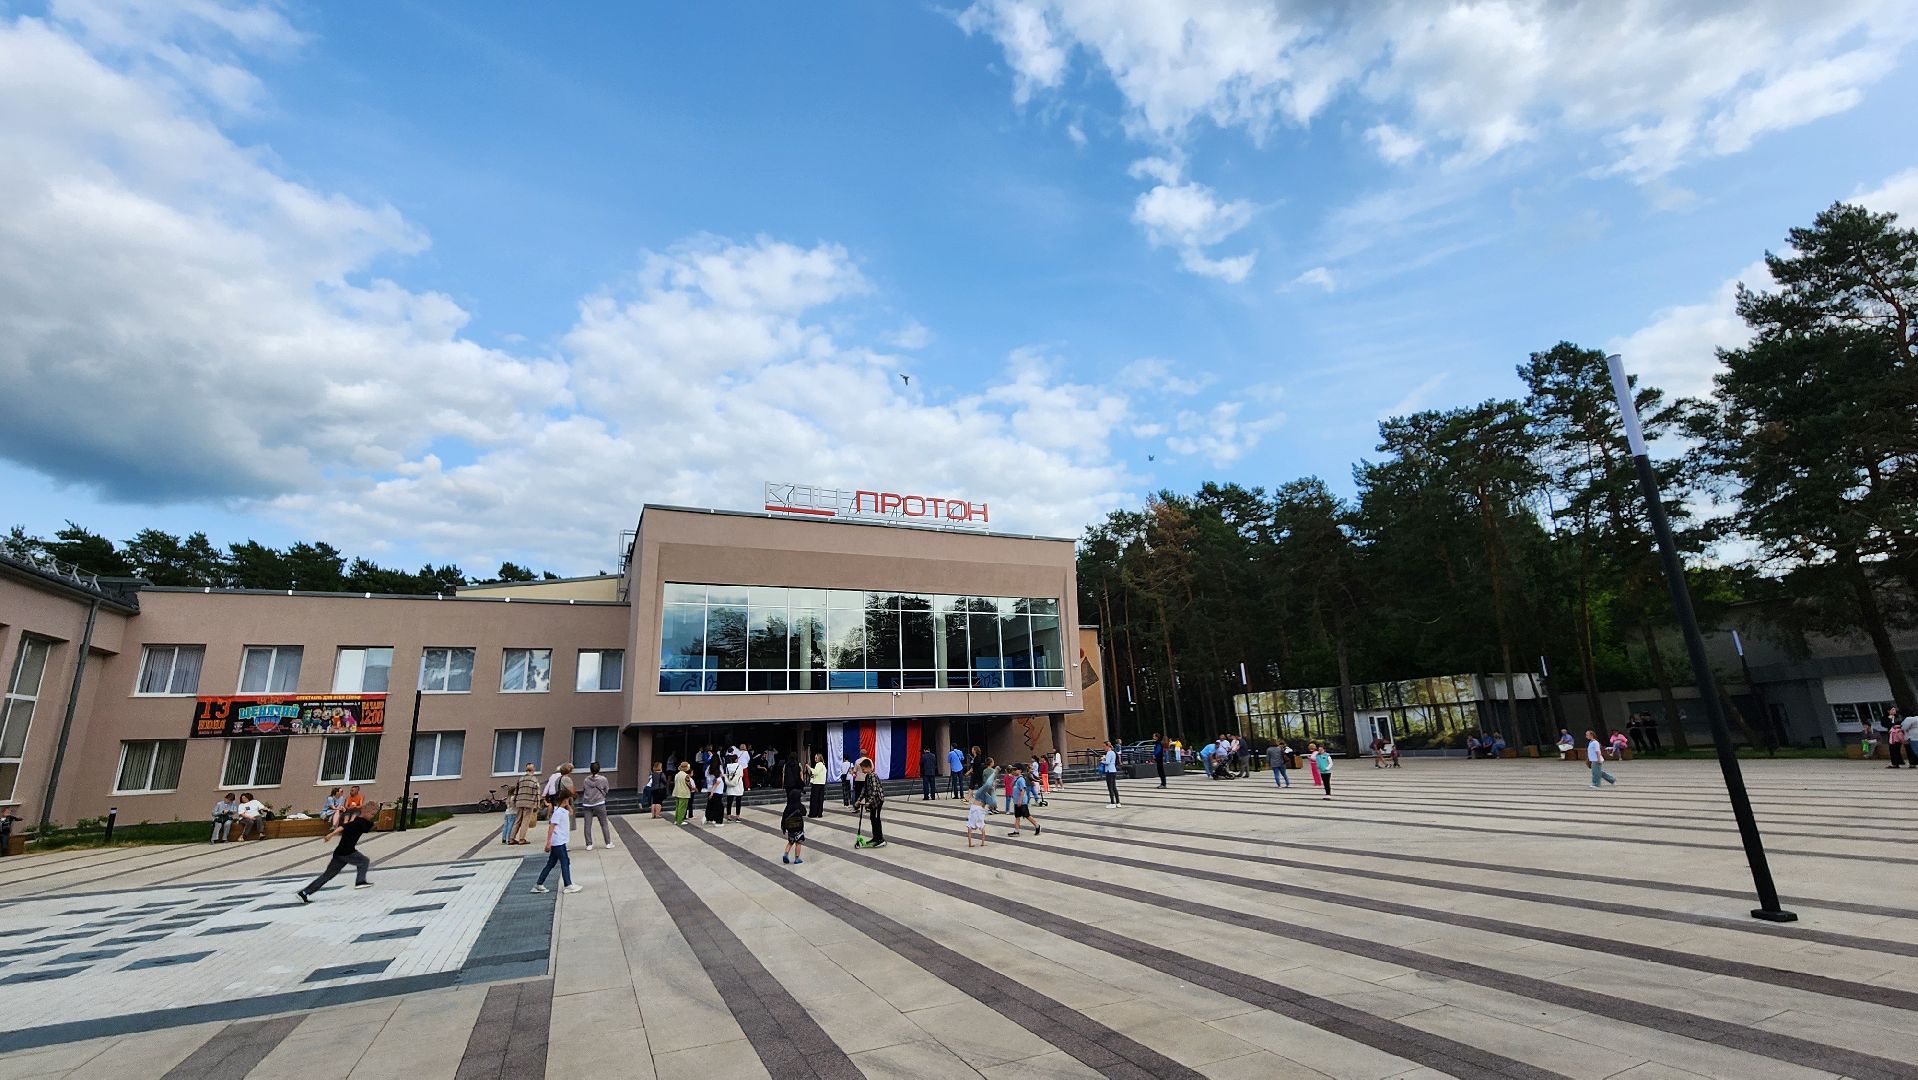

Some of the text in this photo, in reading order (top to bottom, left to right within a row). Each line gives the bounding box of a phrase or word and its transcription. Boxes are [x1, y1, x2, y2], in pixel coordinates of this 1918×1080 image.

[855, 490, 989, 522] ПРОТОН
[201, 696, 232, 718] 13
[360, 709, 383, 725] 12:00
